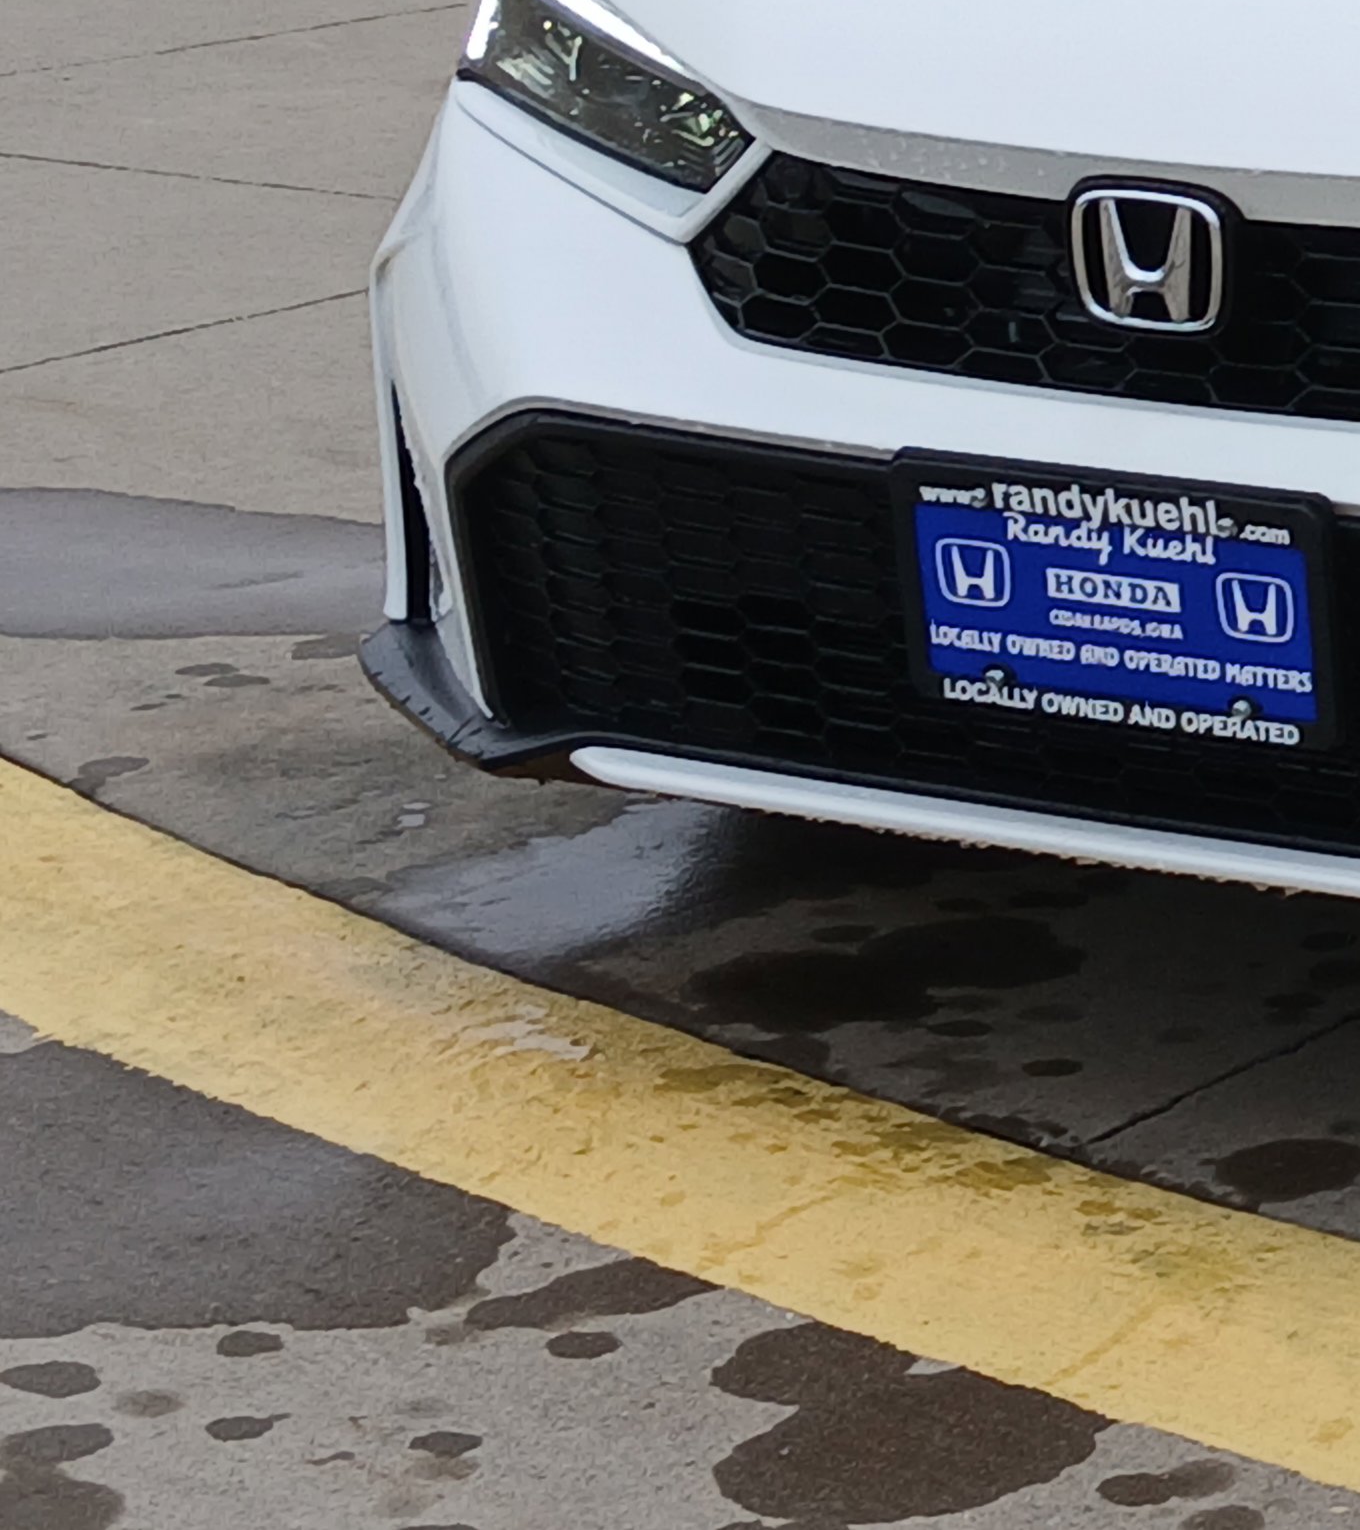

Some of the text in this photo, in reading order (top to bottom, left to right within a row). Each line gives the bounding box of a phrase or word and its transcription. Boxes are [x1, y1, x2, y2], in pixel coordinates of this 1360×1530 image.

[1003, 511, 1216, 565] Randy Kuehl
[1053, 573, 1172, 607] HONDA
[929, 622, 1002, 653] LOCALLY
[1006, 634, 1076, 661] OWNED
[1123, 649, 1221, 681] OPERATED
[1225, 662, 1313, 693] MATTERS
[943, 677, 1300, 746] LOCALLY OWNED AND OPERATED
